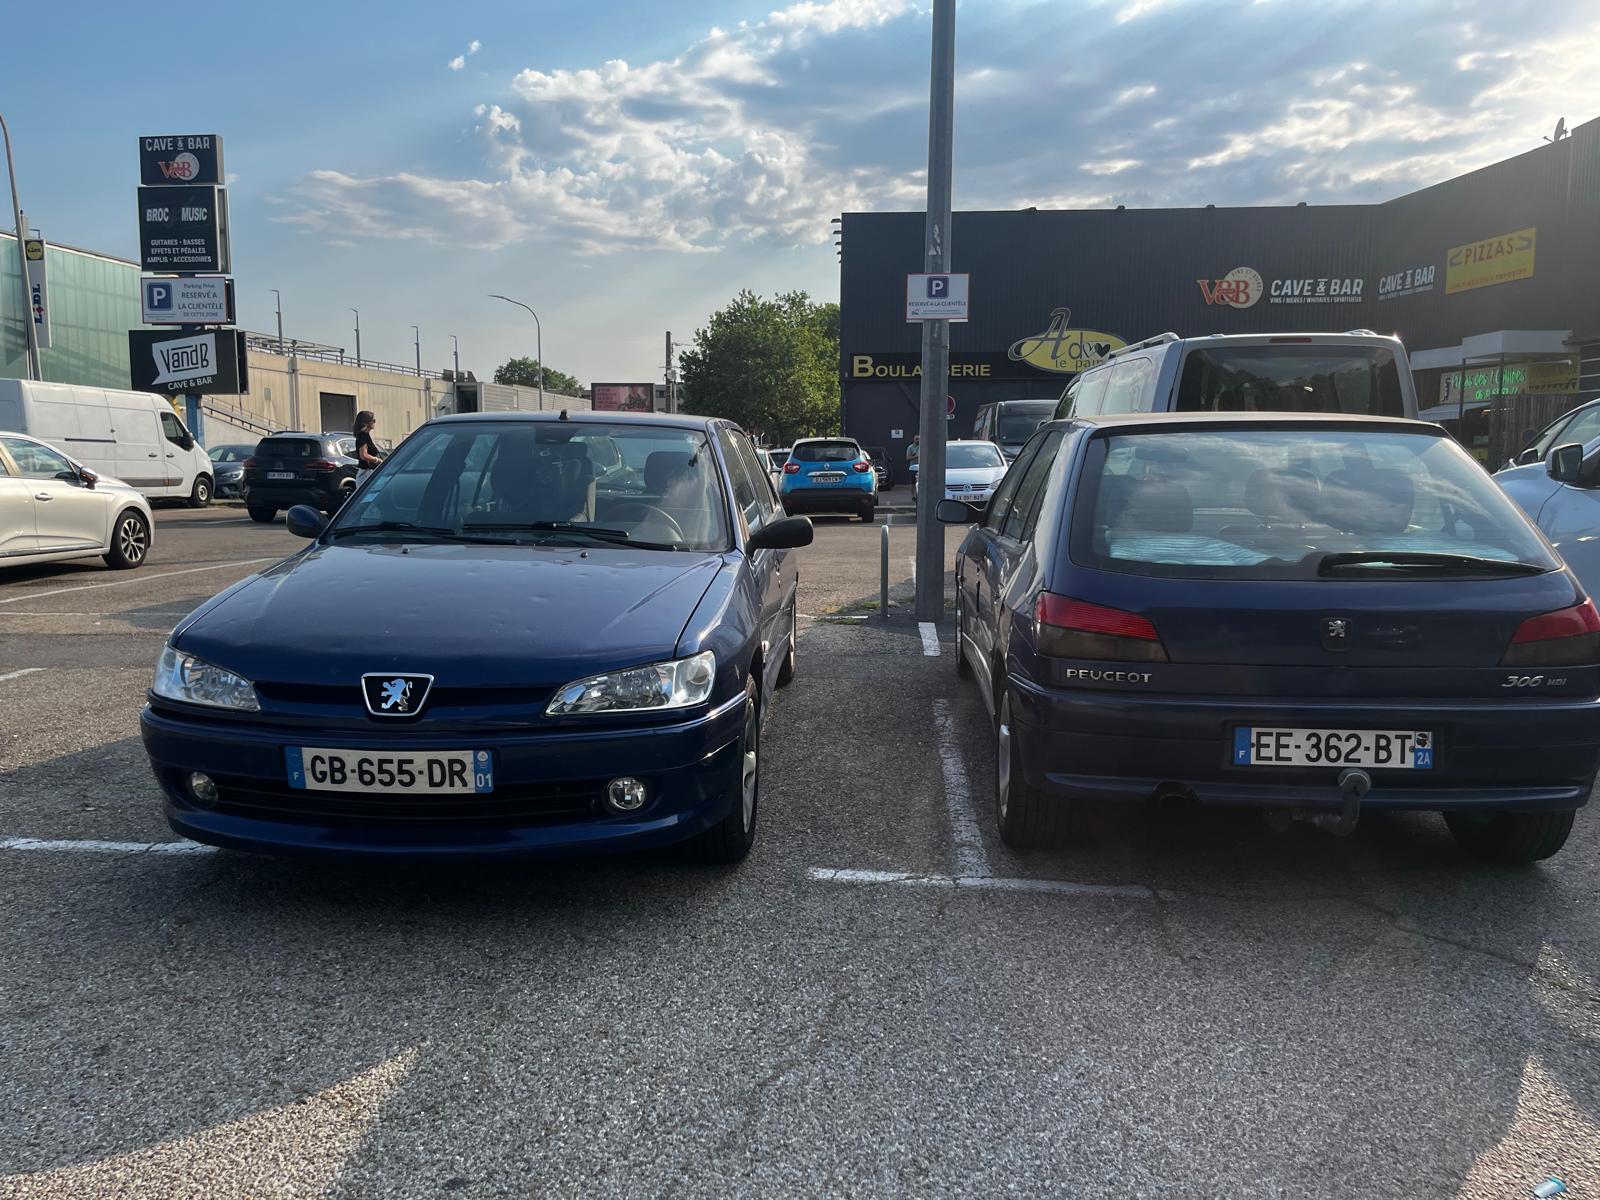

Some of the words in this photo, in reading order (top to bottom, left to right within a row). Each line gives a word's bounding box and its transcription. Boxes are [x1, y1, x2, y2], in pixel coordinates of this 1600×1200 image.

[145, 138, 174, 151] CAVE
[177, 137, 184, 150] &
[187, 137, 211, 150] BAR
[146, 207, 169, 222] BROC
[181, 207, 208, 221] MUSIC
[180, 246, 206, 254] PÉDALES
[1464, 237, 1514, 265] PIZZAS
[173, 255, 212, 263] ACCESSOIRES
[1270, 279, 1315, 296] CAVE
[1315, 278, 1329, 296] &
[1329, 278, 1365, 296] BAR
[1379, 273, 1404, 294] CAVE
[1414, 265, 1436, 287] BAR
[932, 280, 944, 295] P
[152, 287, 167, 306] P
[187, 301, 224, 310] CLIENTÈLE
[852, 355, 991, 377] BOULAERIE
[1055, 359, 1067, 368] le
[167, 380, 189, 391] CAVE
[196, 376, 213, 386] BAR
[1066, 668, 1153, 683] PEUGEOT
[1501, 675, 1545, 688] 306
[1239, 750, 1246, 758] F
[1255, 731, 1412, 765] EE-362-BT
[1417, 752, 1430, 765] 2A
[293, 772, 300, 781] F
[310, 755, 468, 788] GB-655-DR
[476, 773, 492, 788] 01
